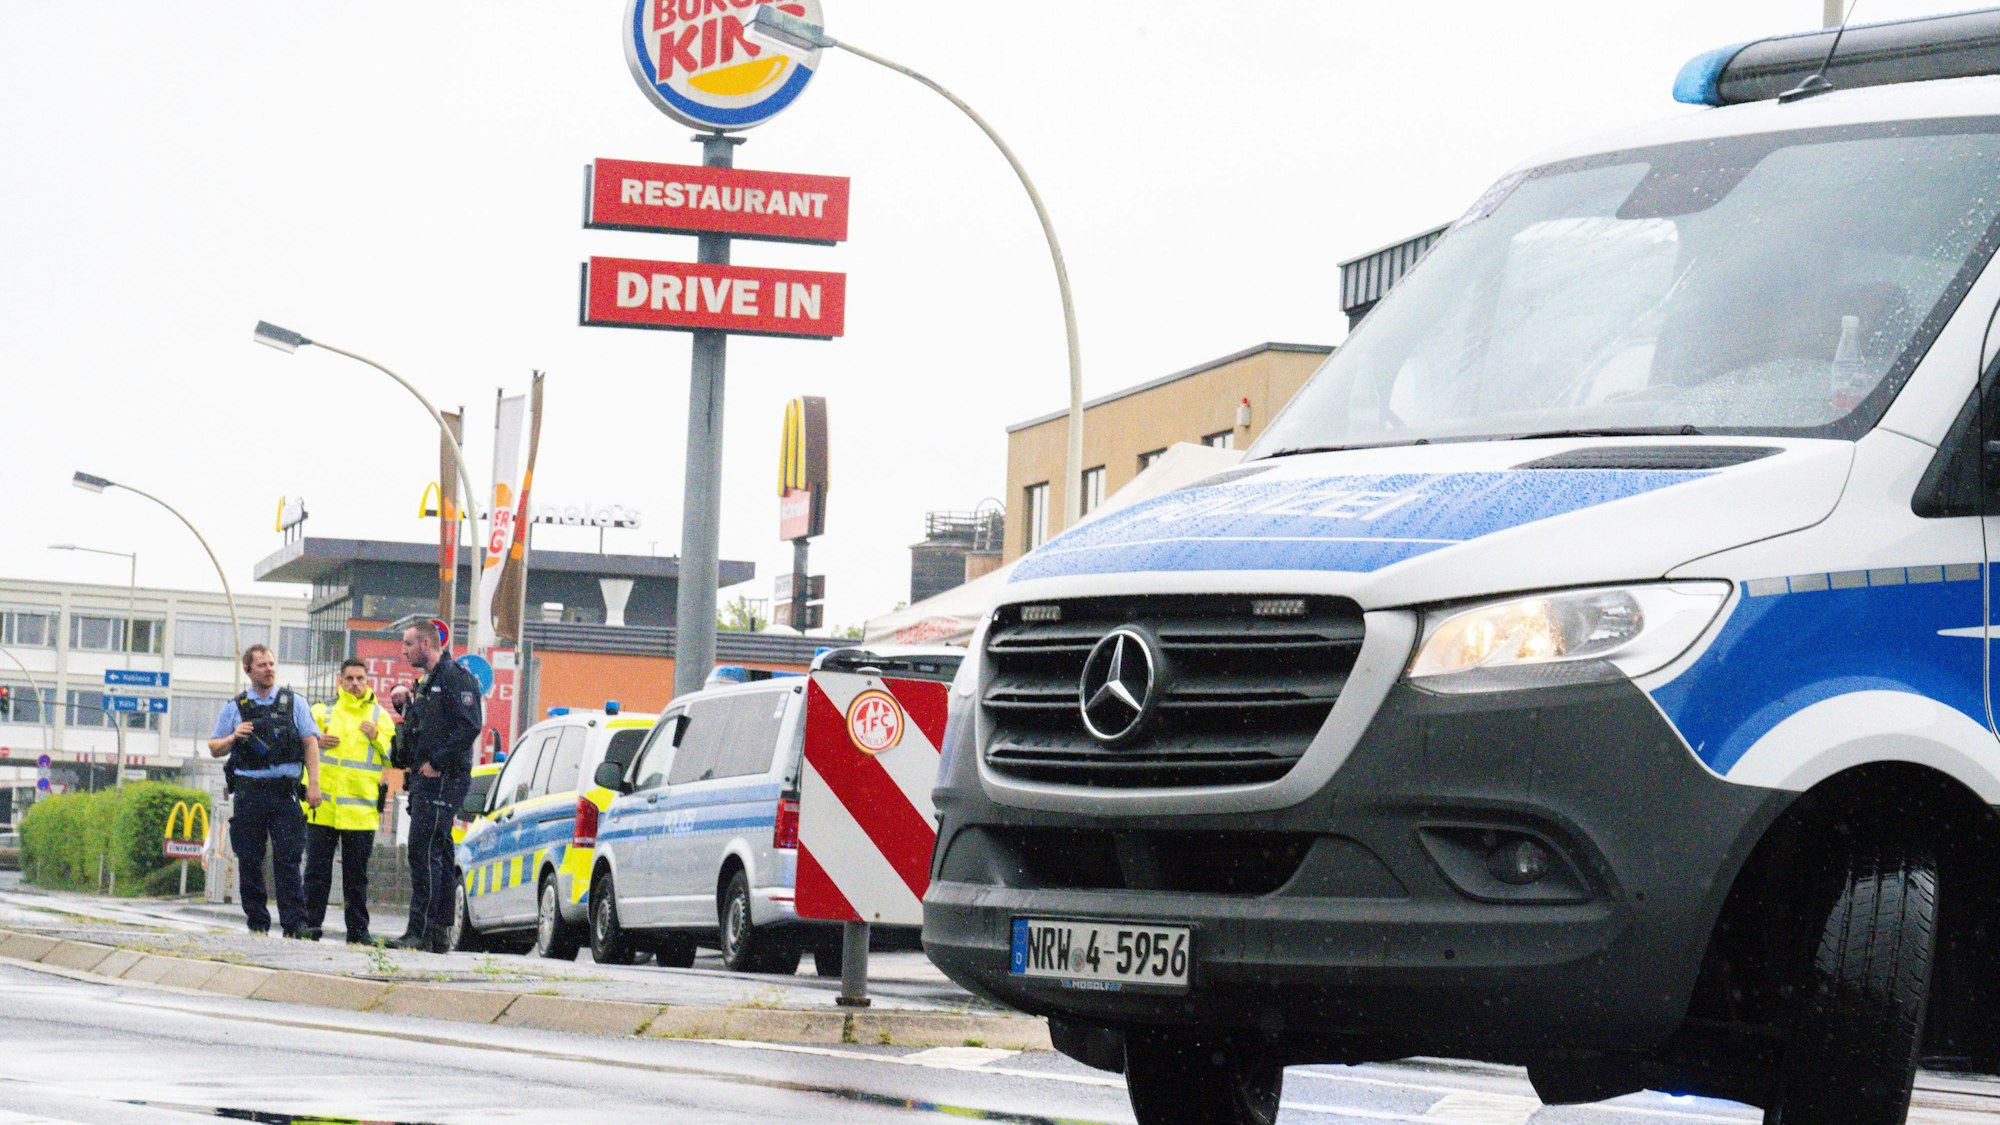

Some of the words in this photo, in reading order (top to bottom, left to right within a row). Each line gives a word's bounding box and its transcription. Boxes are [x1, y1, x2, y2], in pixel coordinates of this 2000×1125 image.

[658, 4, 805, 81] KIN
[621, 178, 828, 219] RESTAURANT
[616, 271, 760, 317] DRIVE
[774, 282, 822, 320] IN
[1015, 951, 1023, 966] D
[1026, 926, 1072, 971] NRW
[1085, 929, 1187, 978] 4-5956
